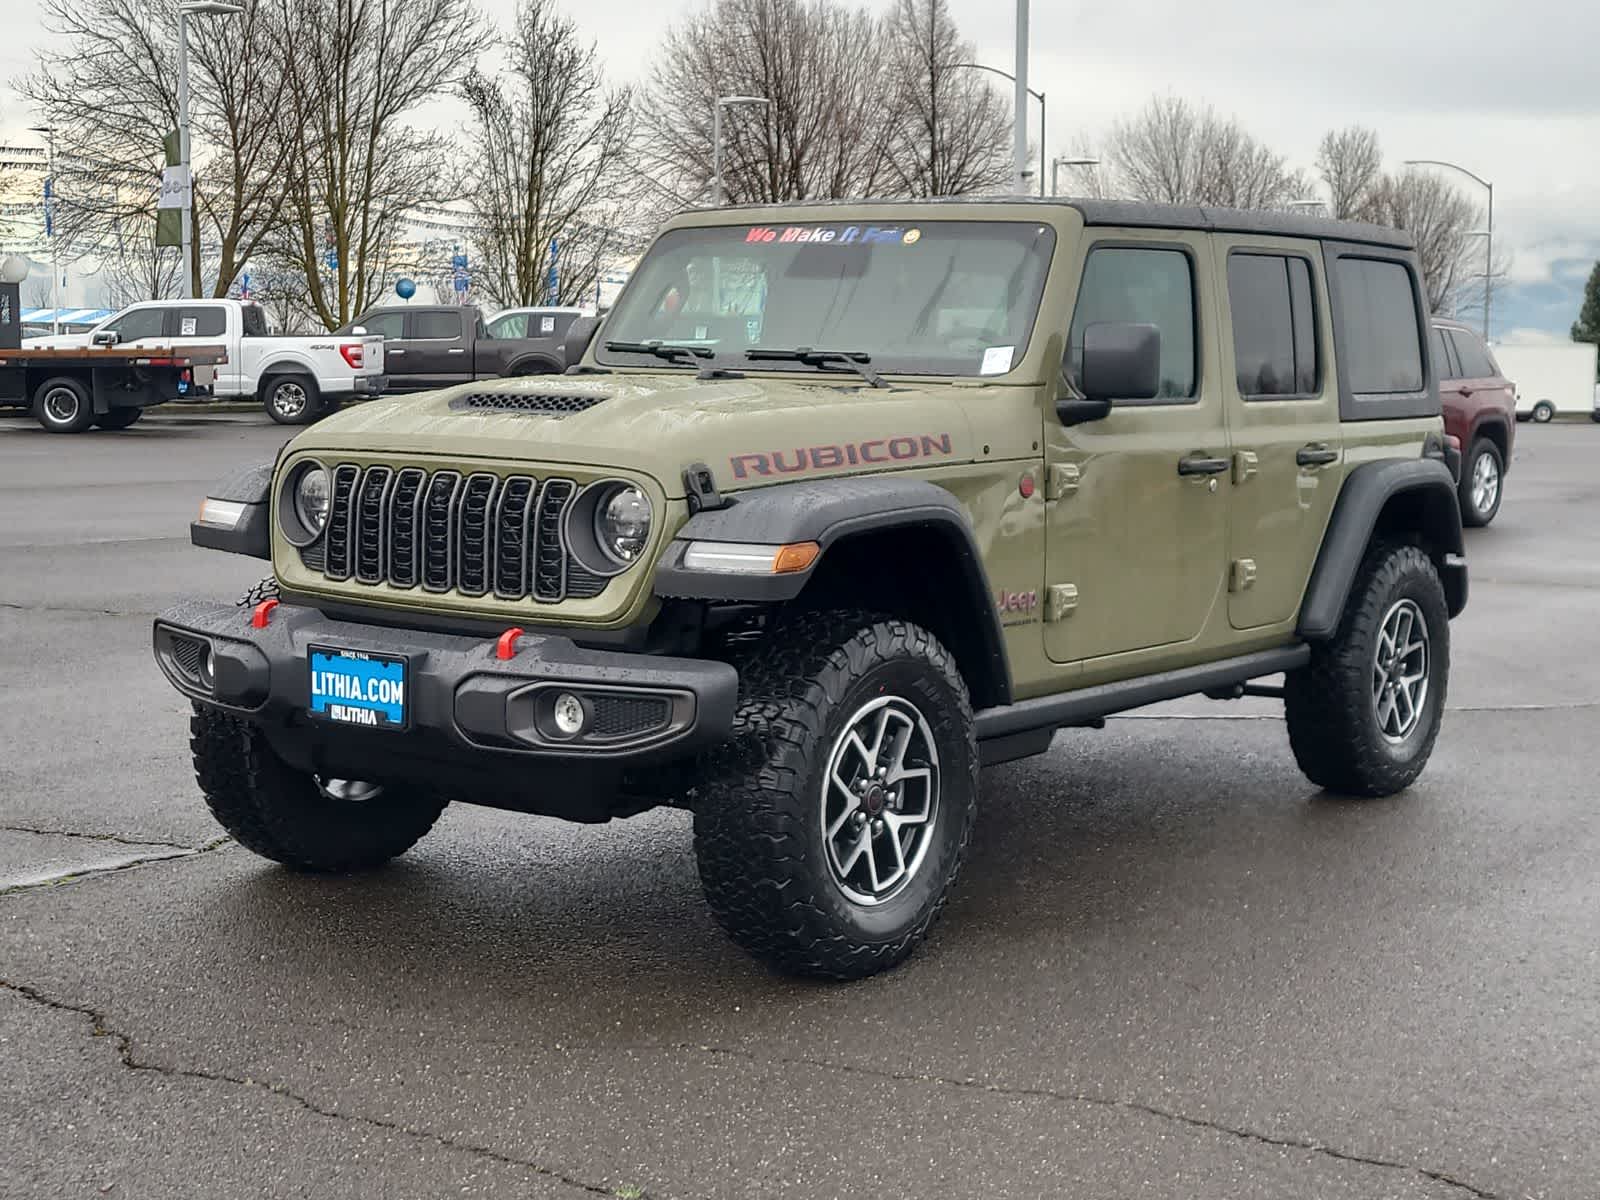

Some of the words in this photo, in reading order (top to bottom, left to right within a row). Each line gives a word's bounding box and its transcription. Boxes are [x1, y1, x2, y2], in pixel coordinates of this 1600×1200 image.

[779, 226, 836, 243] Make
[729, 433, 953, 480] RUBICON
[993, 590, 1037, 615] Jeep
[311, 671, 403, 705] LITHIA.COM
[341, 705, 377, 725] LITHIA
